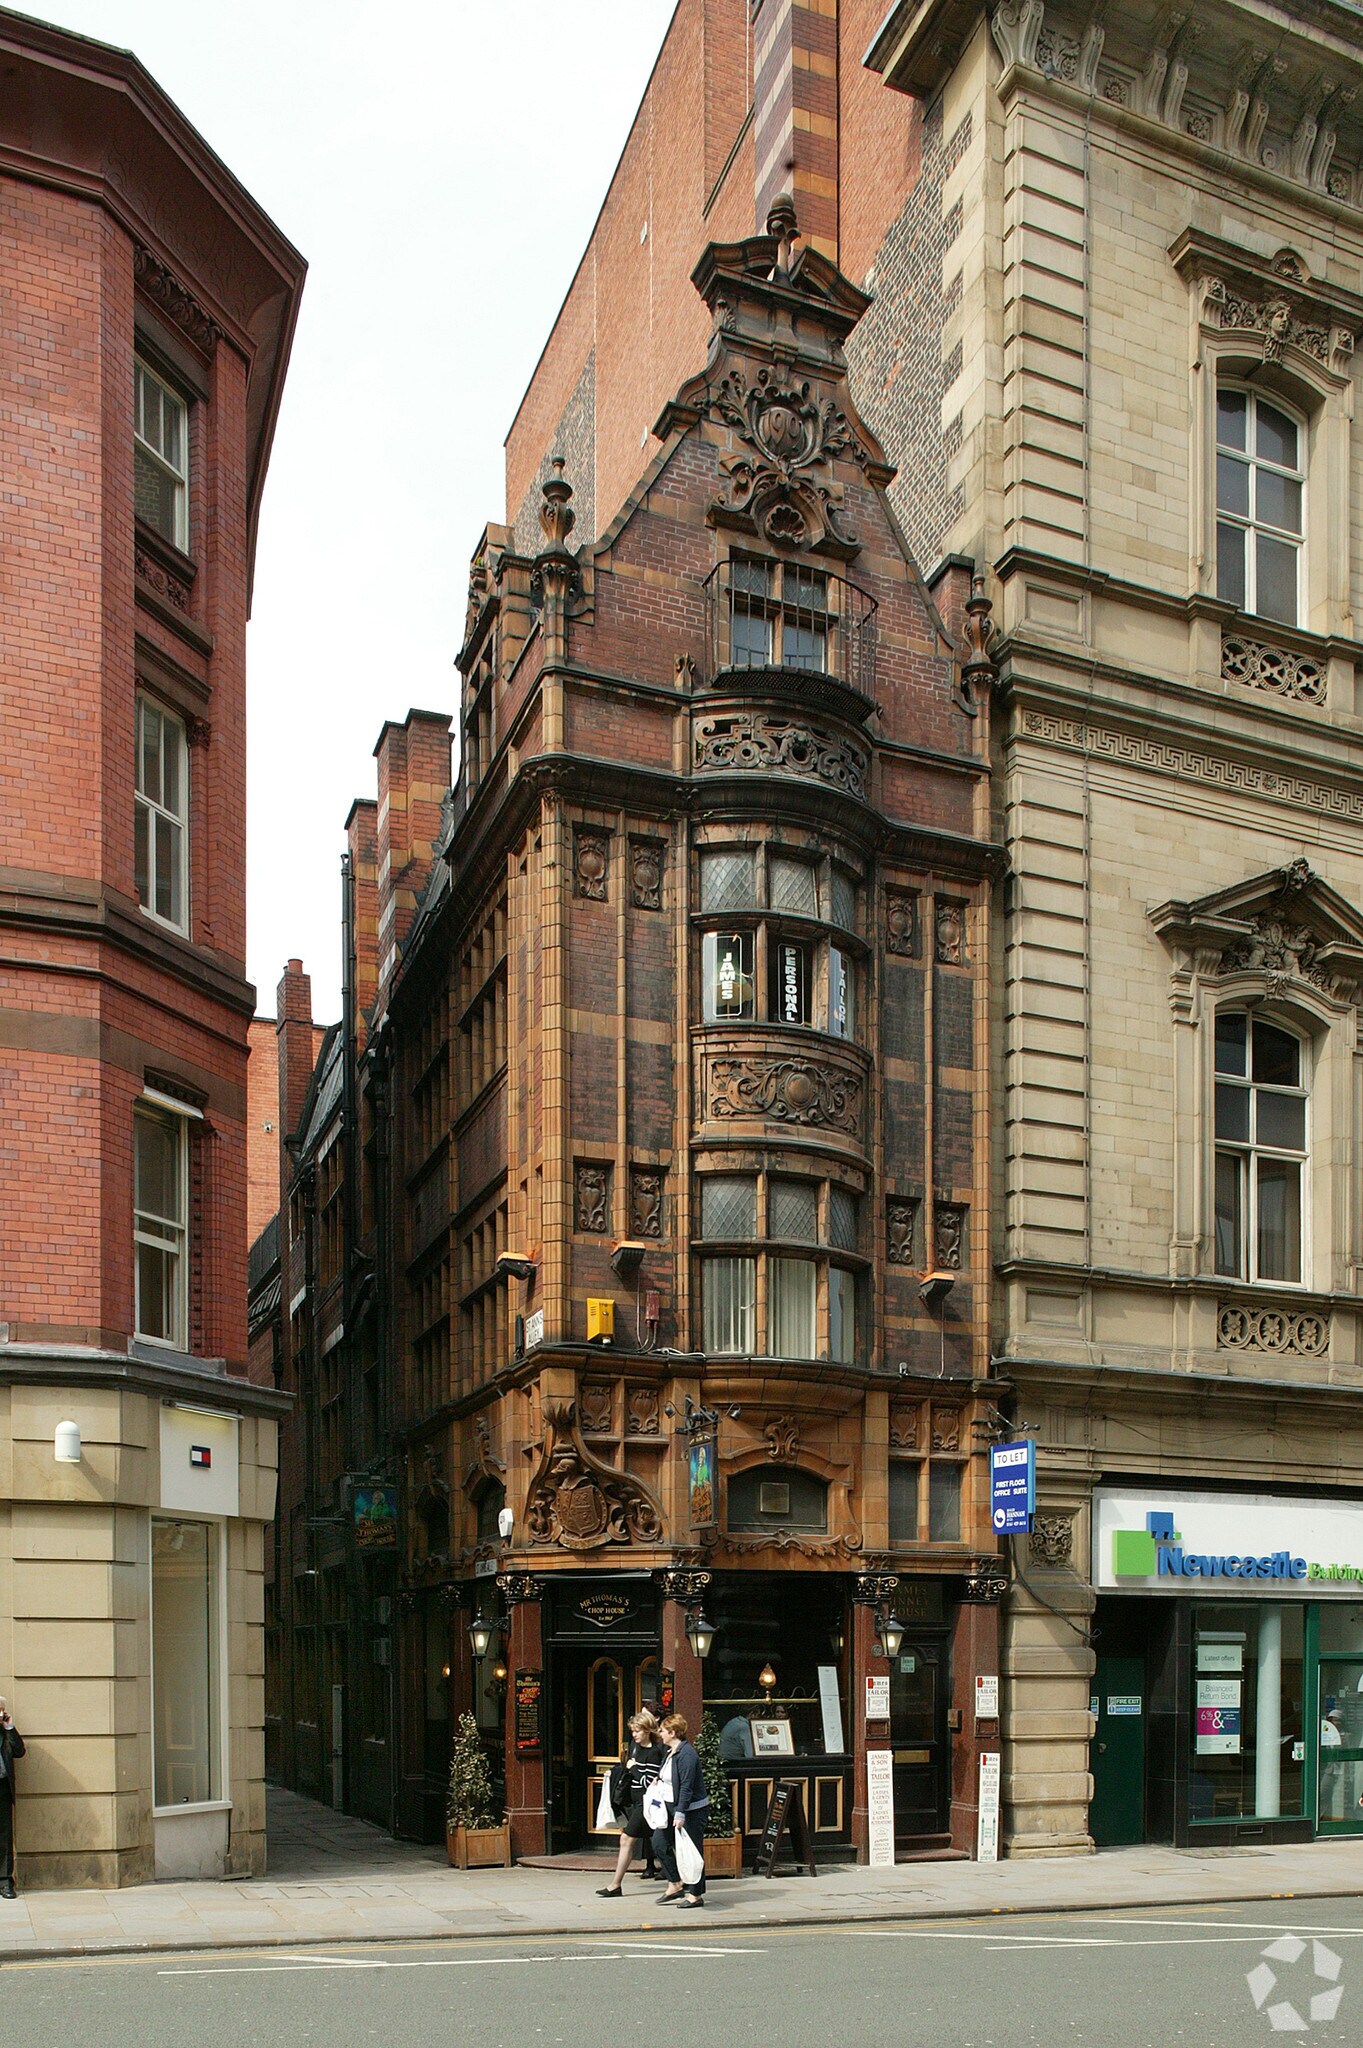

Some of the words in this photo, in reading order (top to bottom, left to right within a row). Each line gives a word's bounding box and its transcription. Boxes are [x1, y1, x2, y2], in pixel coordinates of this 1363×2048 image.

[719, 952, 736, 1000] JAMES
[784, 947, 798, 1022] PERSONAL
[838, 970, 847, 1024] TAILOR
[997, 1454, 1008, 1464] TO
[1009, 1452, 1024, 1463] LET
[996, 1481, 1009, 1489] FIRST
[1009, 1479, 1026, 1488] FLOOR
[994, 1489, 1011, 1498] OFFICE
[1013, 1487, 1028, 1496] SUITE
[866, 1554, 889, 1570] 52
[977, 1557, 997, 1573] 52
[1157, 1546, 1308, 1579] Newcastle
[894, 1585, 927, 1595] AMES
[580, 1599, 591, 1609] MR
[591, 1593, 630, 1606] THOMAS'S
[895, 1607, 927, 1617] OUSE
[1205, 1684, 1233, 1692] Balanced
[1200, 1692, 1219, 1700] Return
[1220, 1692, 1237, 1700] Bond
[1200, 1710, 1213, 1721] 6%
[1212, 1710, 1225, 1729] &
